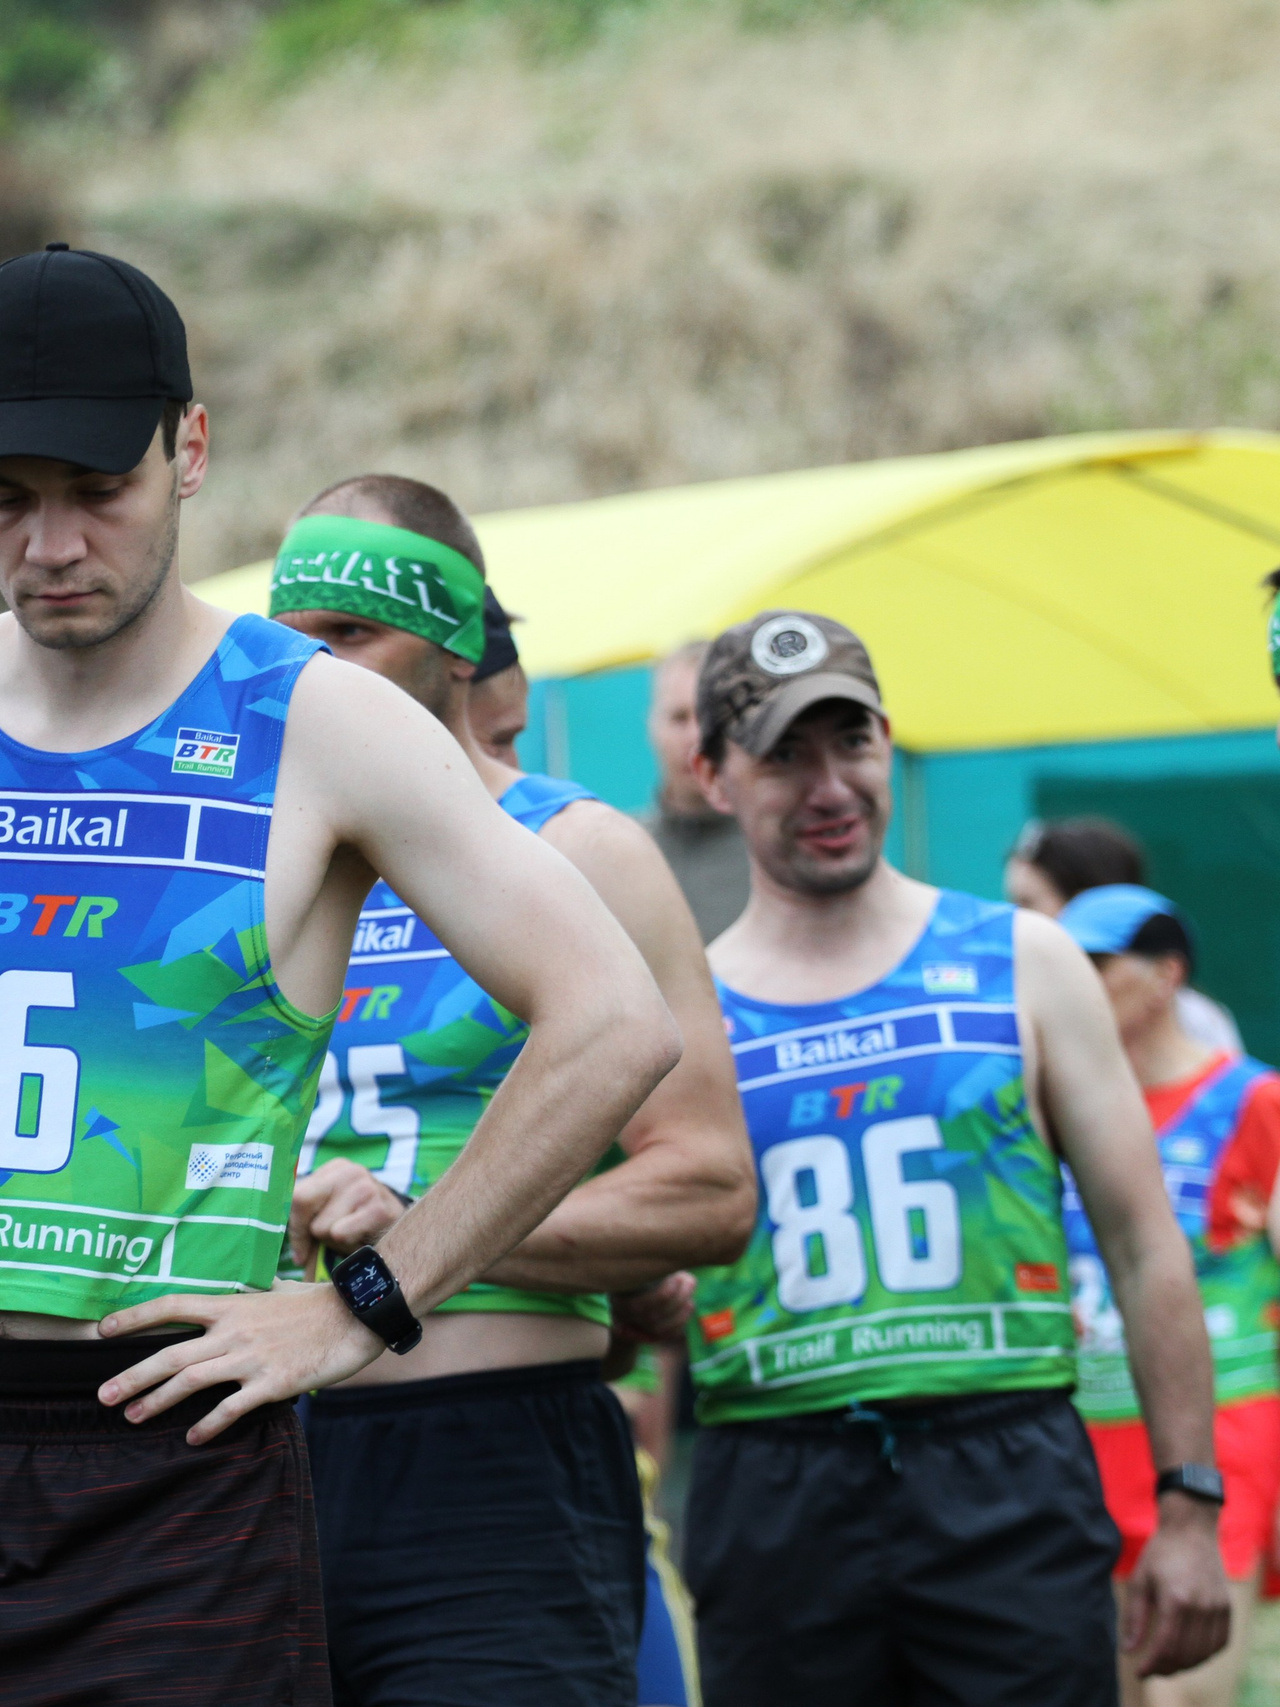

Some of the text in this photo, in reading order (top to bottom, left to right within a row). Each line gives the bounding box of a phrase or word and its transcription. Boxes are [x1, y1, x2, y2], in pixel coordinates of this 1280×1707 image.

[176, 743, 235, 763] BTR
[195, 732, 223, 743] Baikal
[177, 762, 230, 775] Trail Running
[352, 917, 417, 953] ikal
[337, 984, 403, 1022] TR
[775, 1021, 898, 1071] Baikal
[788, 1074, 904, 1129] BTR
[760, 1114, 962, 1313] 86
[774, 1317, 984, 1371] Trail Running
